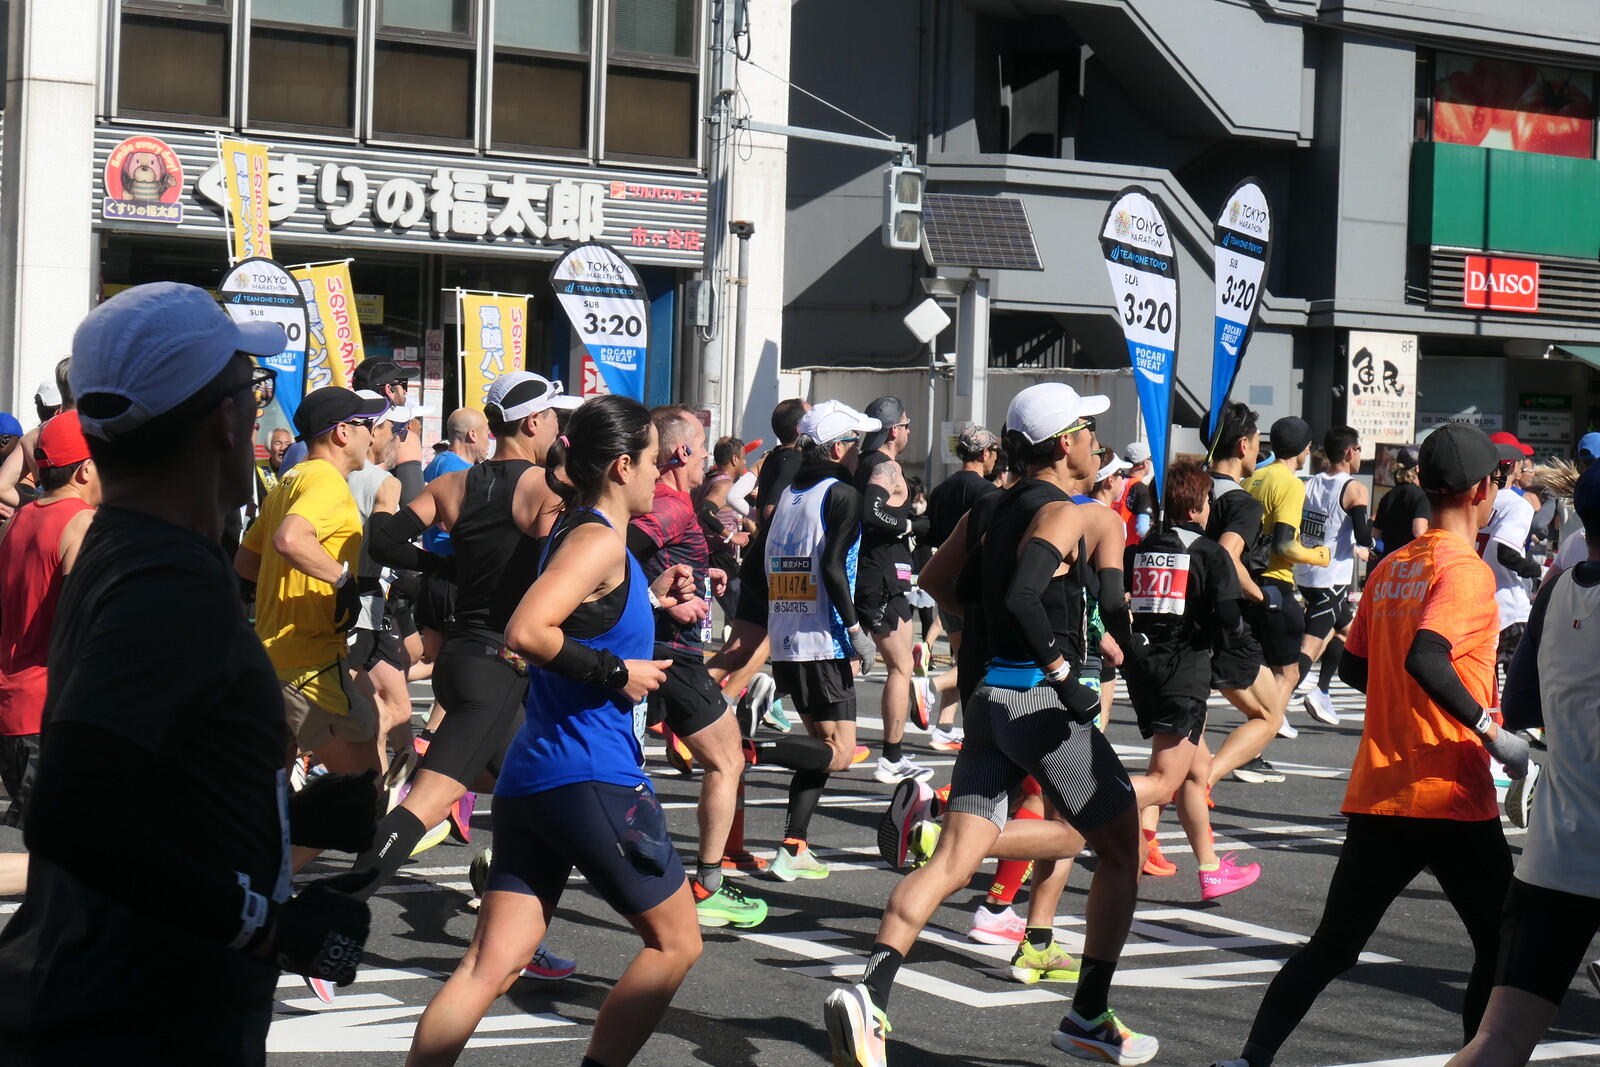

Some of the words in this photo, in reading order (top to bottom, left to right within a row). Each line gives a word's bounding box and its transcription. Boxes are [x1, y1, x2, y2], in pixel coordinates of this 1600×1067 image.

[111, 143, 135, 168] Smile
[135, 141, 163, 155] every
[106, 202, 180, 218] くすりの福太郎
[1242, 203, 1267, 223] TOKYO
[586, 261, 625, 274] TOKYO
[1229, 257, 1238, 269] SUB
[252, 274, 288, 285] TOKYO
[1470, 271, 1535, 295] DAISO
[1222, 275, 1256, 311] 3:20
[584, 300, 600, 309] SUB
[250, 309, 265, 317] SUB
[1124, 293, 1172, 334] 3:20
[583, 312, 642, 337] 3:20
[1223, 323, 1243, 336] POCARI
[327, 277, 358, 390] いのちのタス
[601, 347, 636, 357] POCARI
[1401, 340, 1414, 353] 8F
[265, 357, 292, 365] SWEAT
[601, 354, 633, 363] SWEAT
[1135, 347, 1166, 363] POCARI
[1136, 357, 1162, 371] SWEAT
[1352, 346, 1405, 398] 魚民
[1140, 554, 1175, 568] PACE
[1391, 560, 1426, 579] TEAM
[778, 575, 808, 594] 11474
